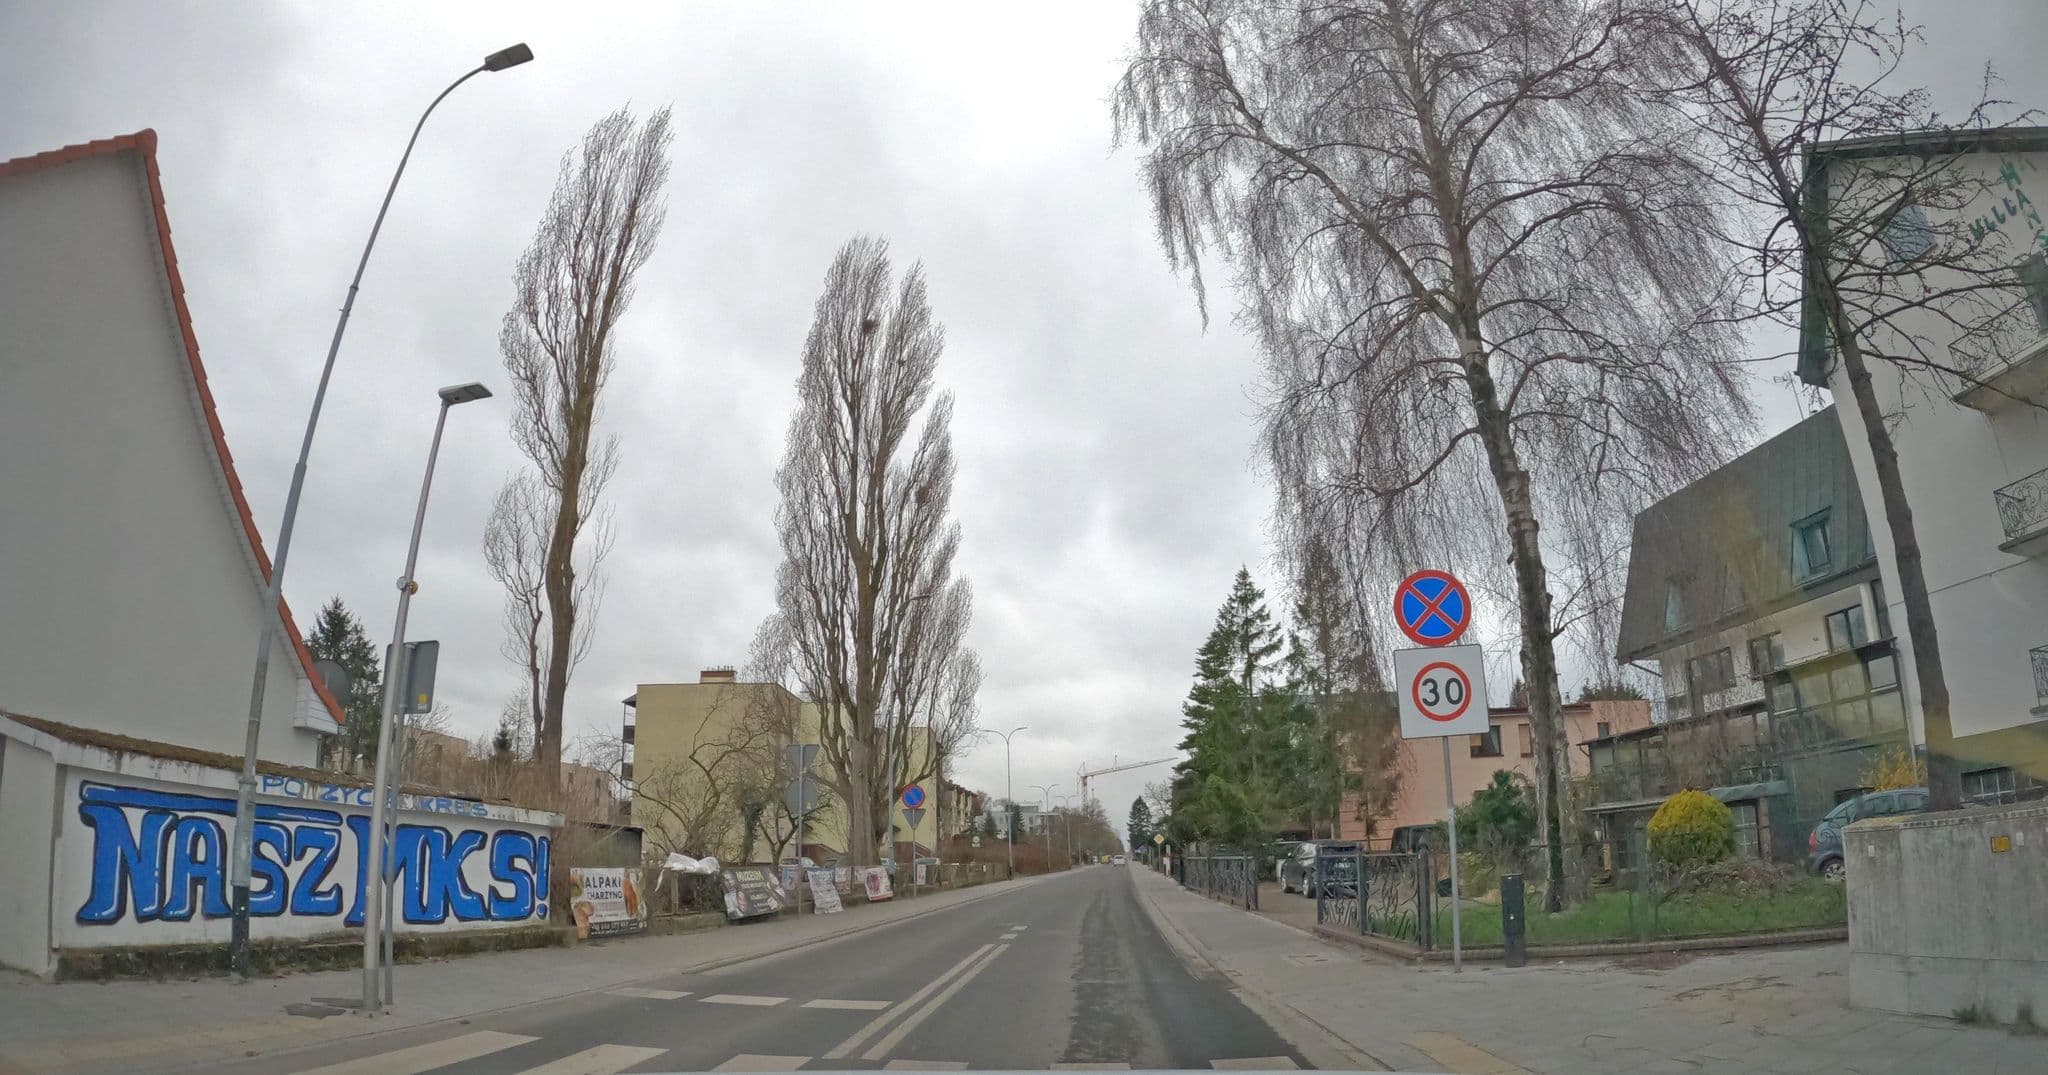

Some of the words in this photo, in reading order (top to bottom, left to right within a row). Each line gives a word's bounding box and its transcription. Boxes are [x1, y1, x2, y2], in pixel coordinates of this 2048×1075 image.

[1422, 677, 1464, 707] 30
[77, 781, 343, 925] NASZ
[585, 876, 622, 889] ALPAKI
